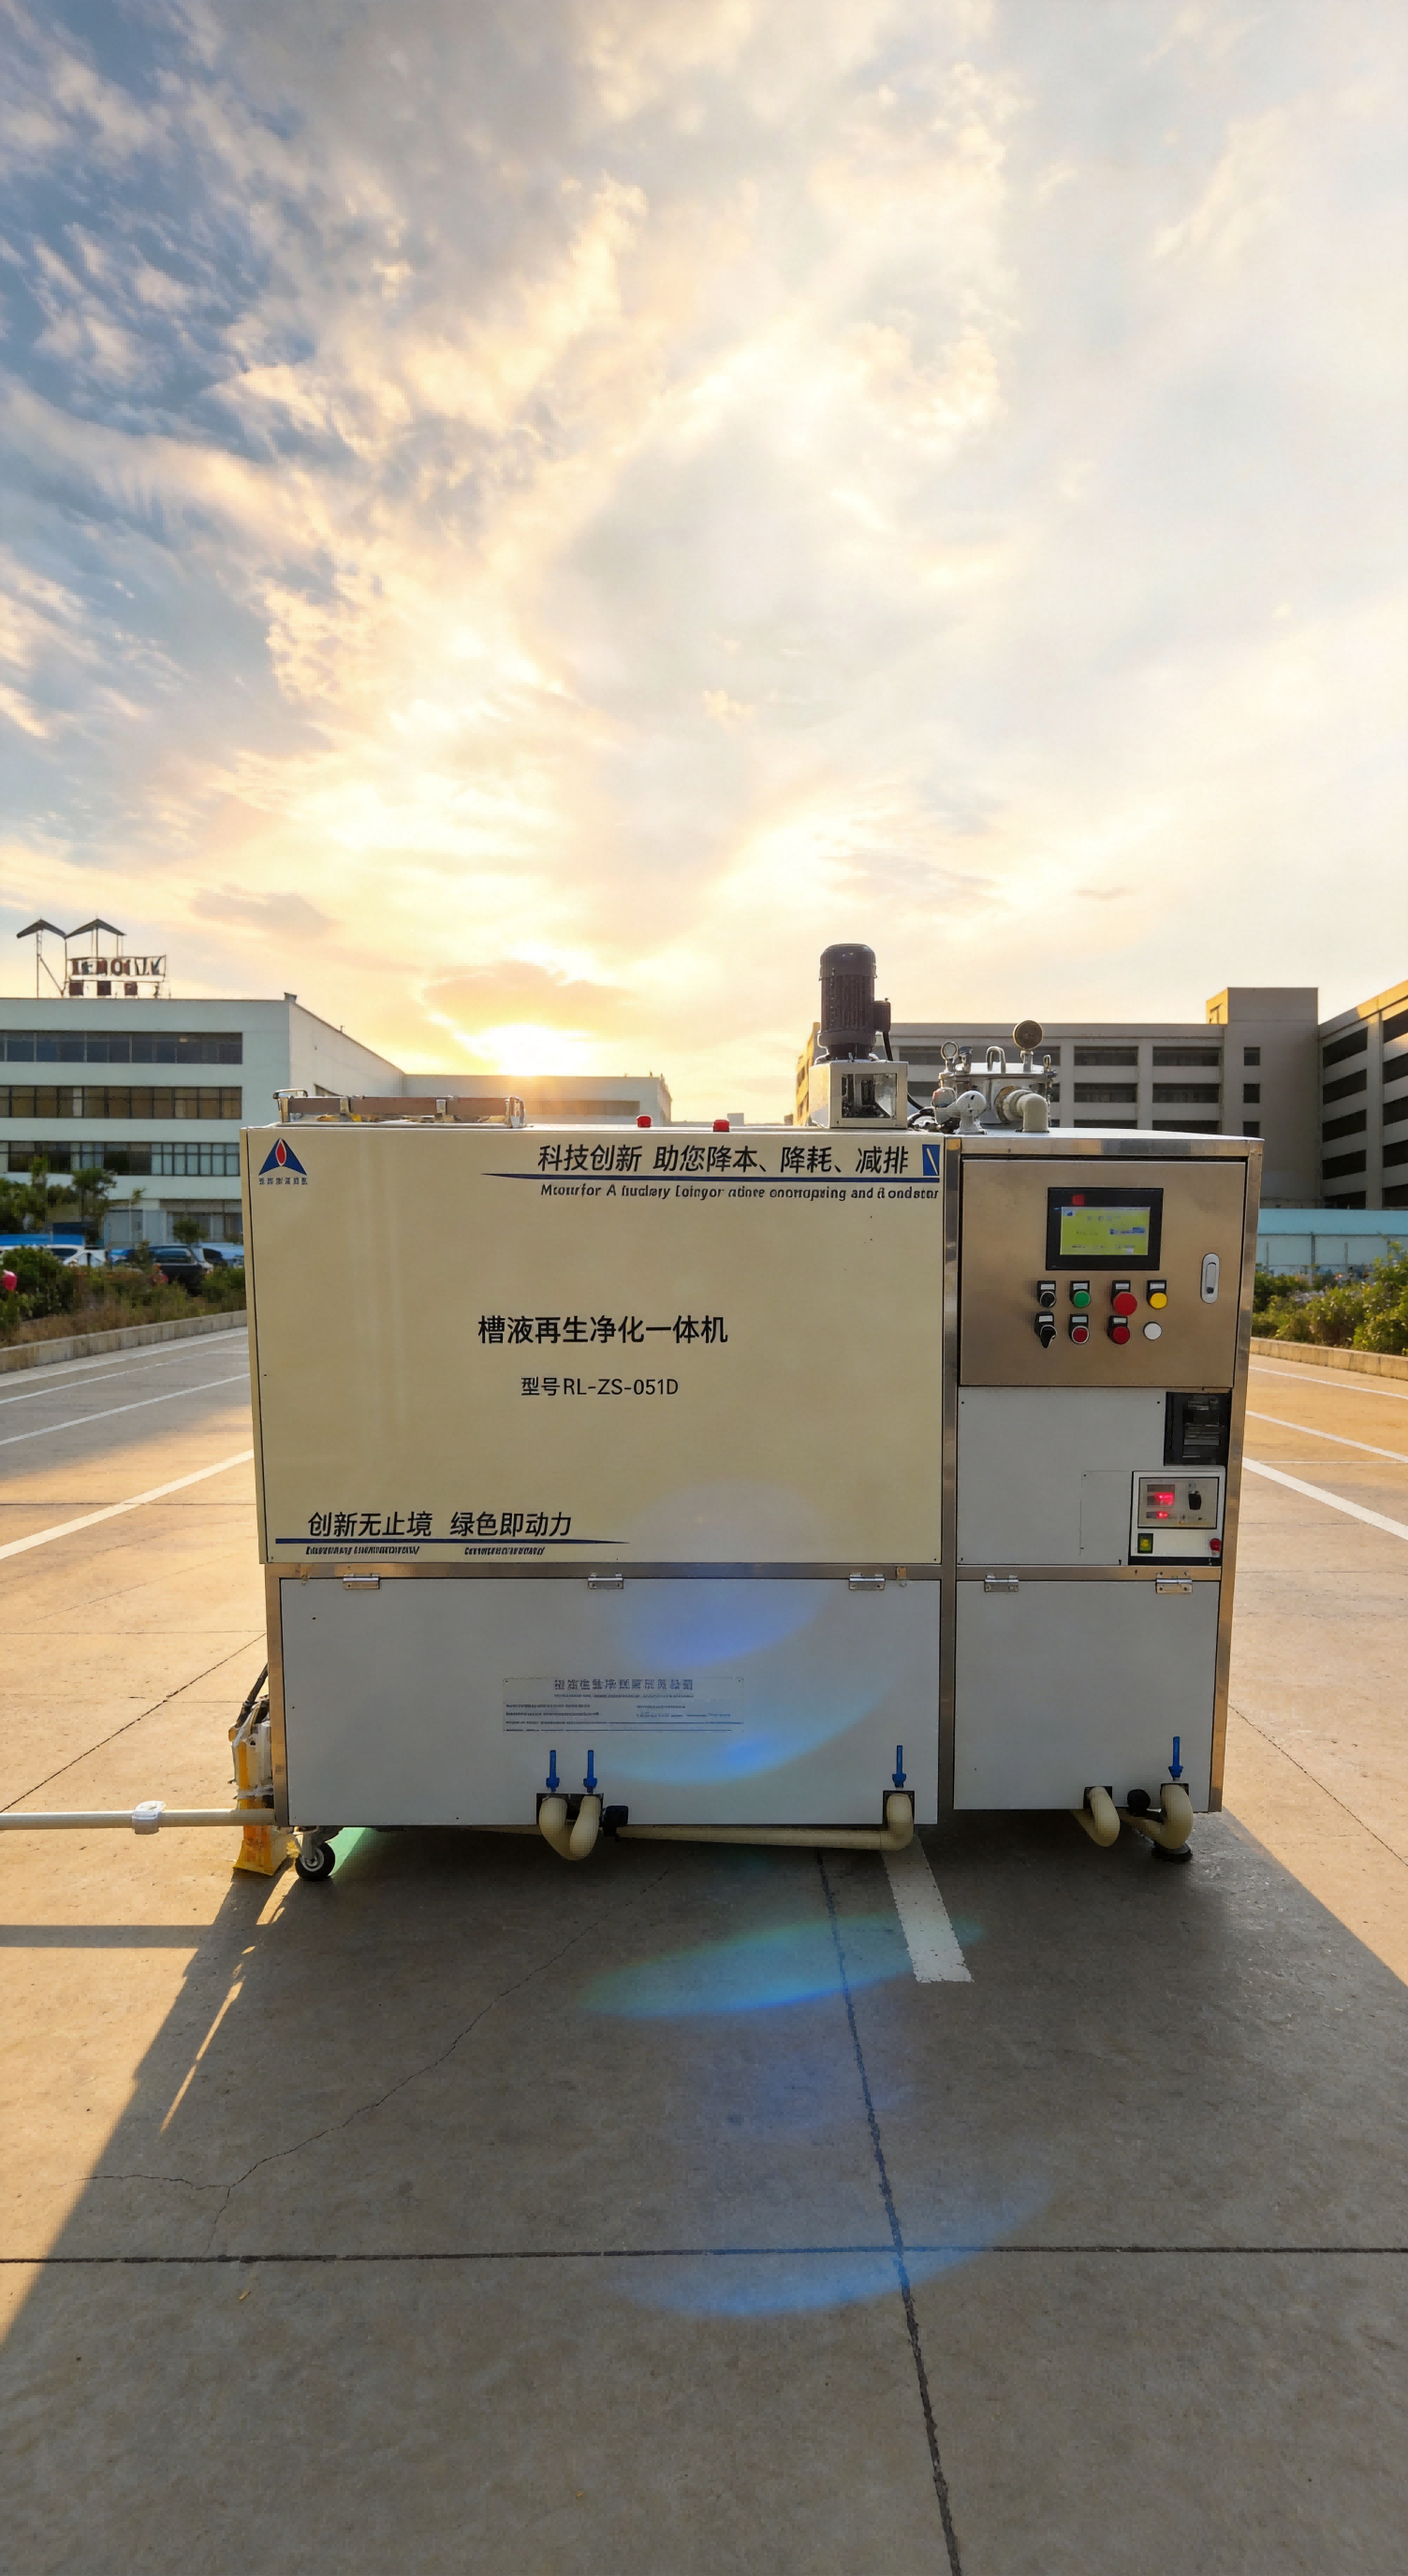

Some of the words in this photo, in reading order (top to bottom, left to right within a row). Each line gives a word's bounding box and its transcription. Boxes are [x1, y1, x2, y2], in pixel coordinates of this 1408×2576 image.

[537, 1144, 643, 1173] 科技创新
[652, 1144, 909, 1175] 助您降本、降耗、减排
[850, 1187, 874, 1199] and
[477, 1315, 728, 1344] 槽液再生净化一体机
[521, 1376, 679, 1397] 型号RL-ZS-051D
[307, 1511, 433, 1538] 创新无止境
[449, 1511, 572, 1538] 绿色即动力
